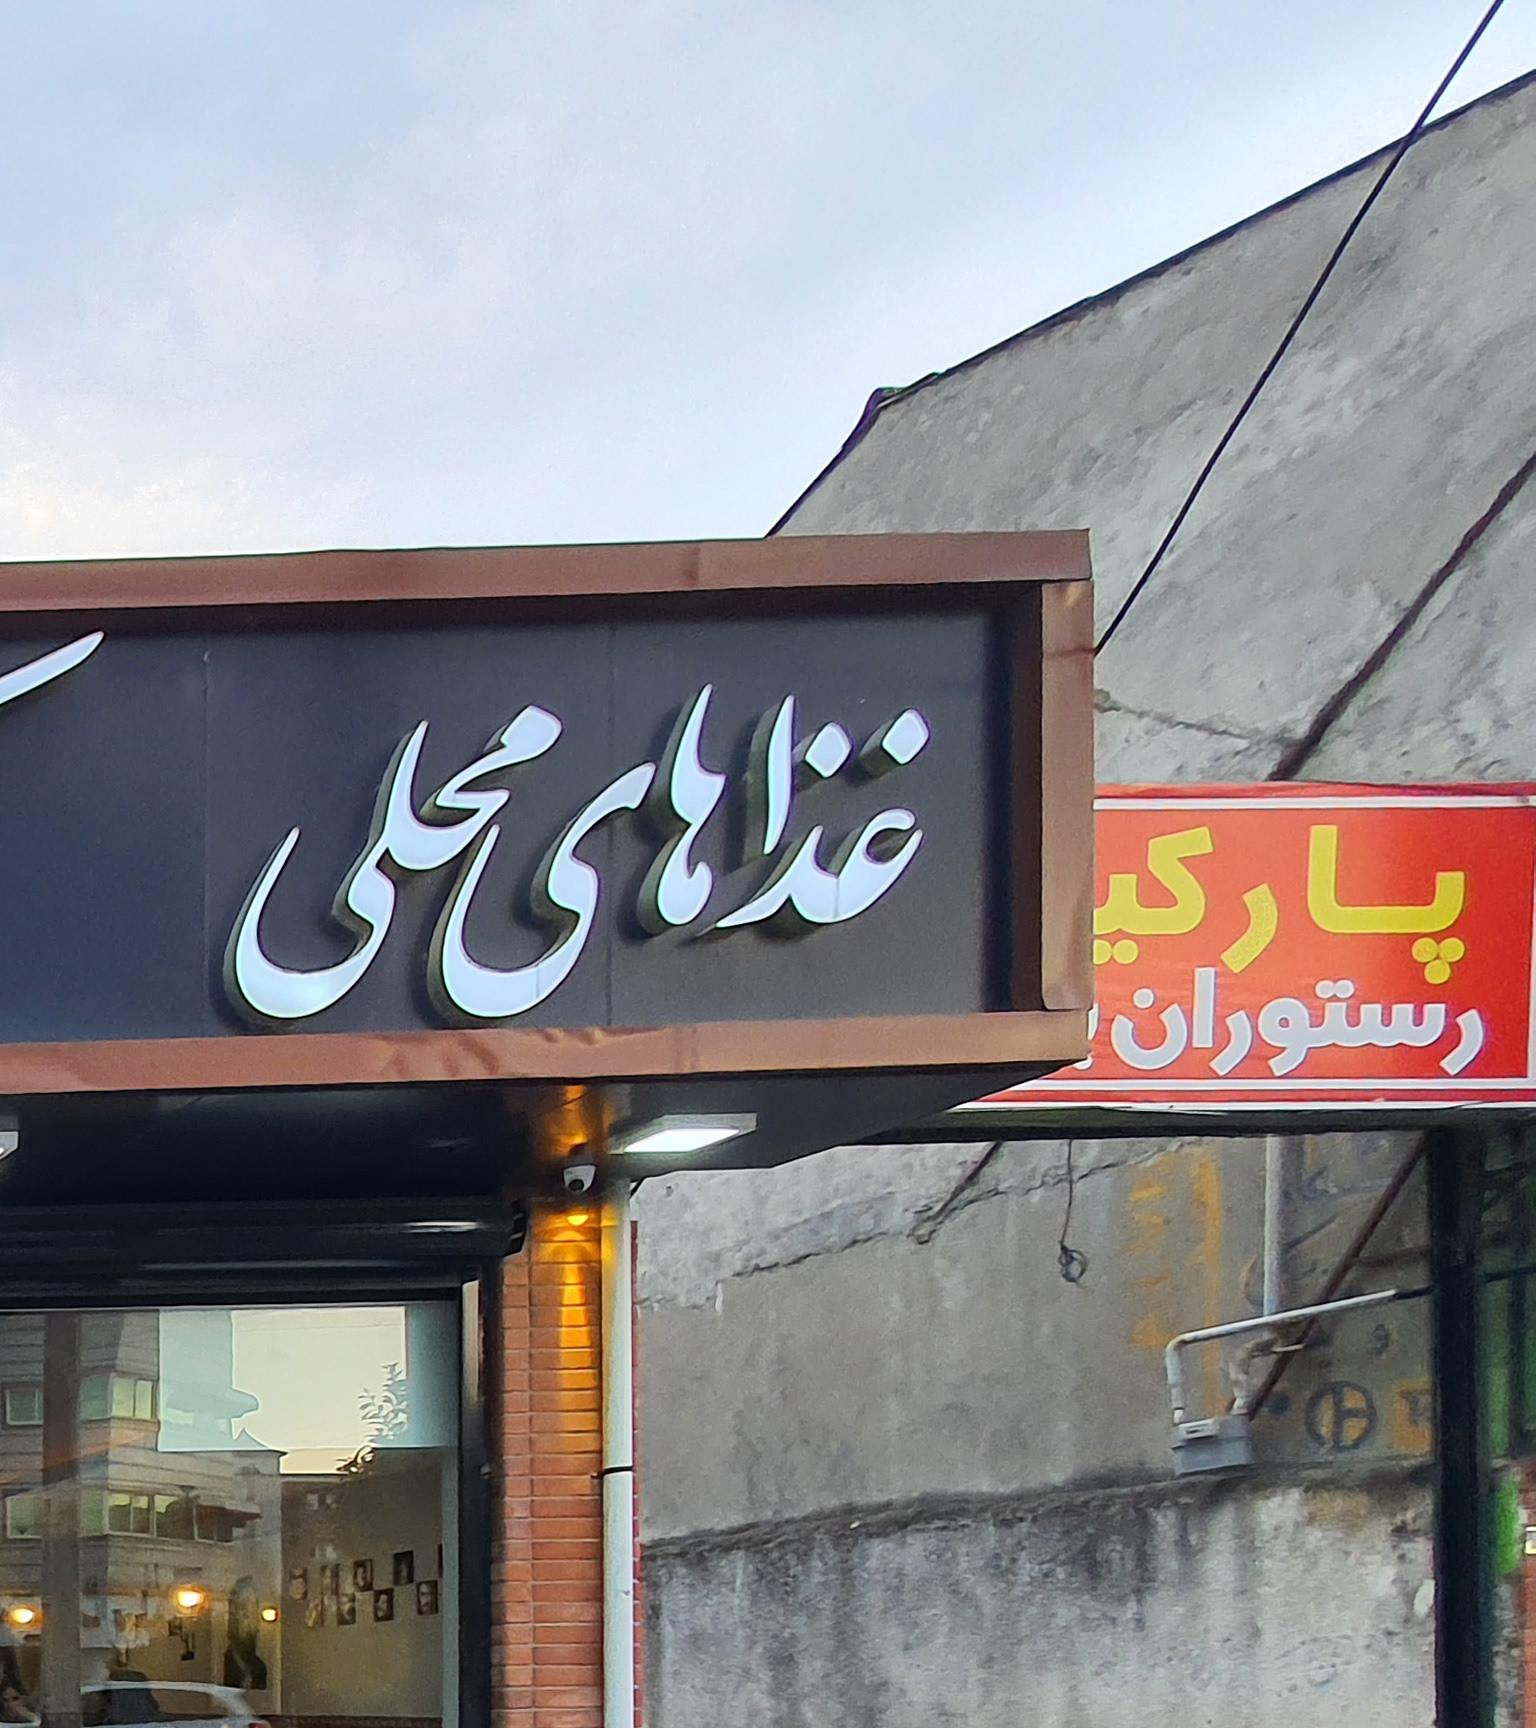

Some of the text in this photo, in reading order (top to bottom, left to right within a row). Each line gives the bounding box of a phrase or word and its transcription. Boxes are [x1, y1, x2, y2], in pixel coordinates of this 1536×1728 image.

[234, 704, 563, 1020] محلی
[1094, 824, 1467, 985] پارکی
[1110, 967, 1484, 1076] رستوران
